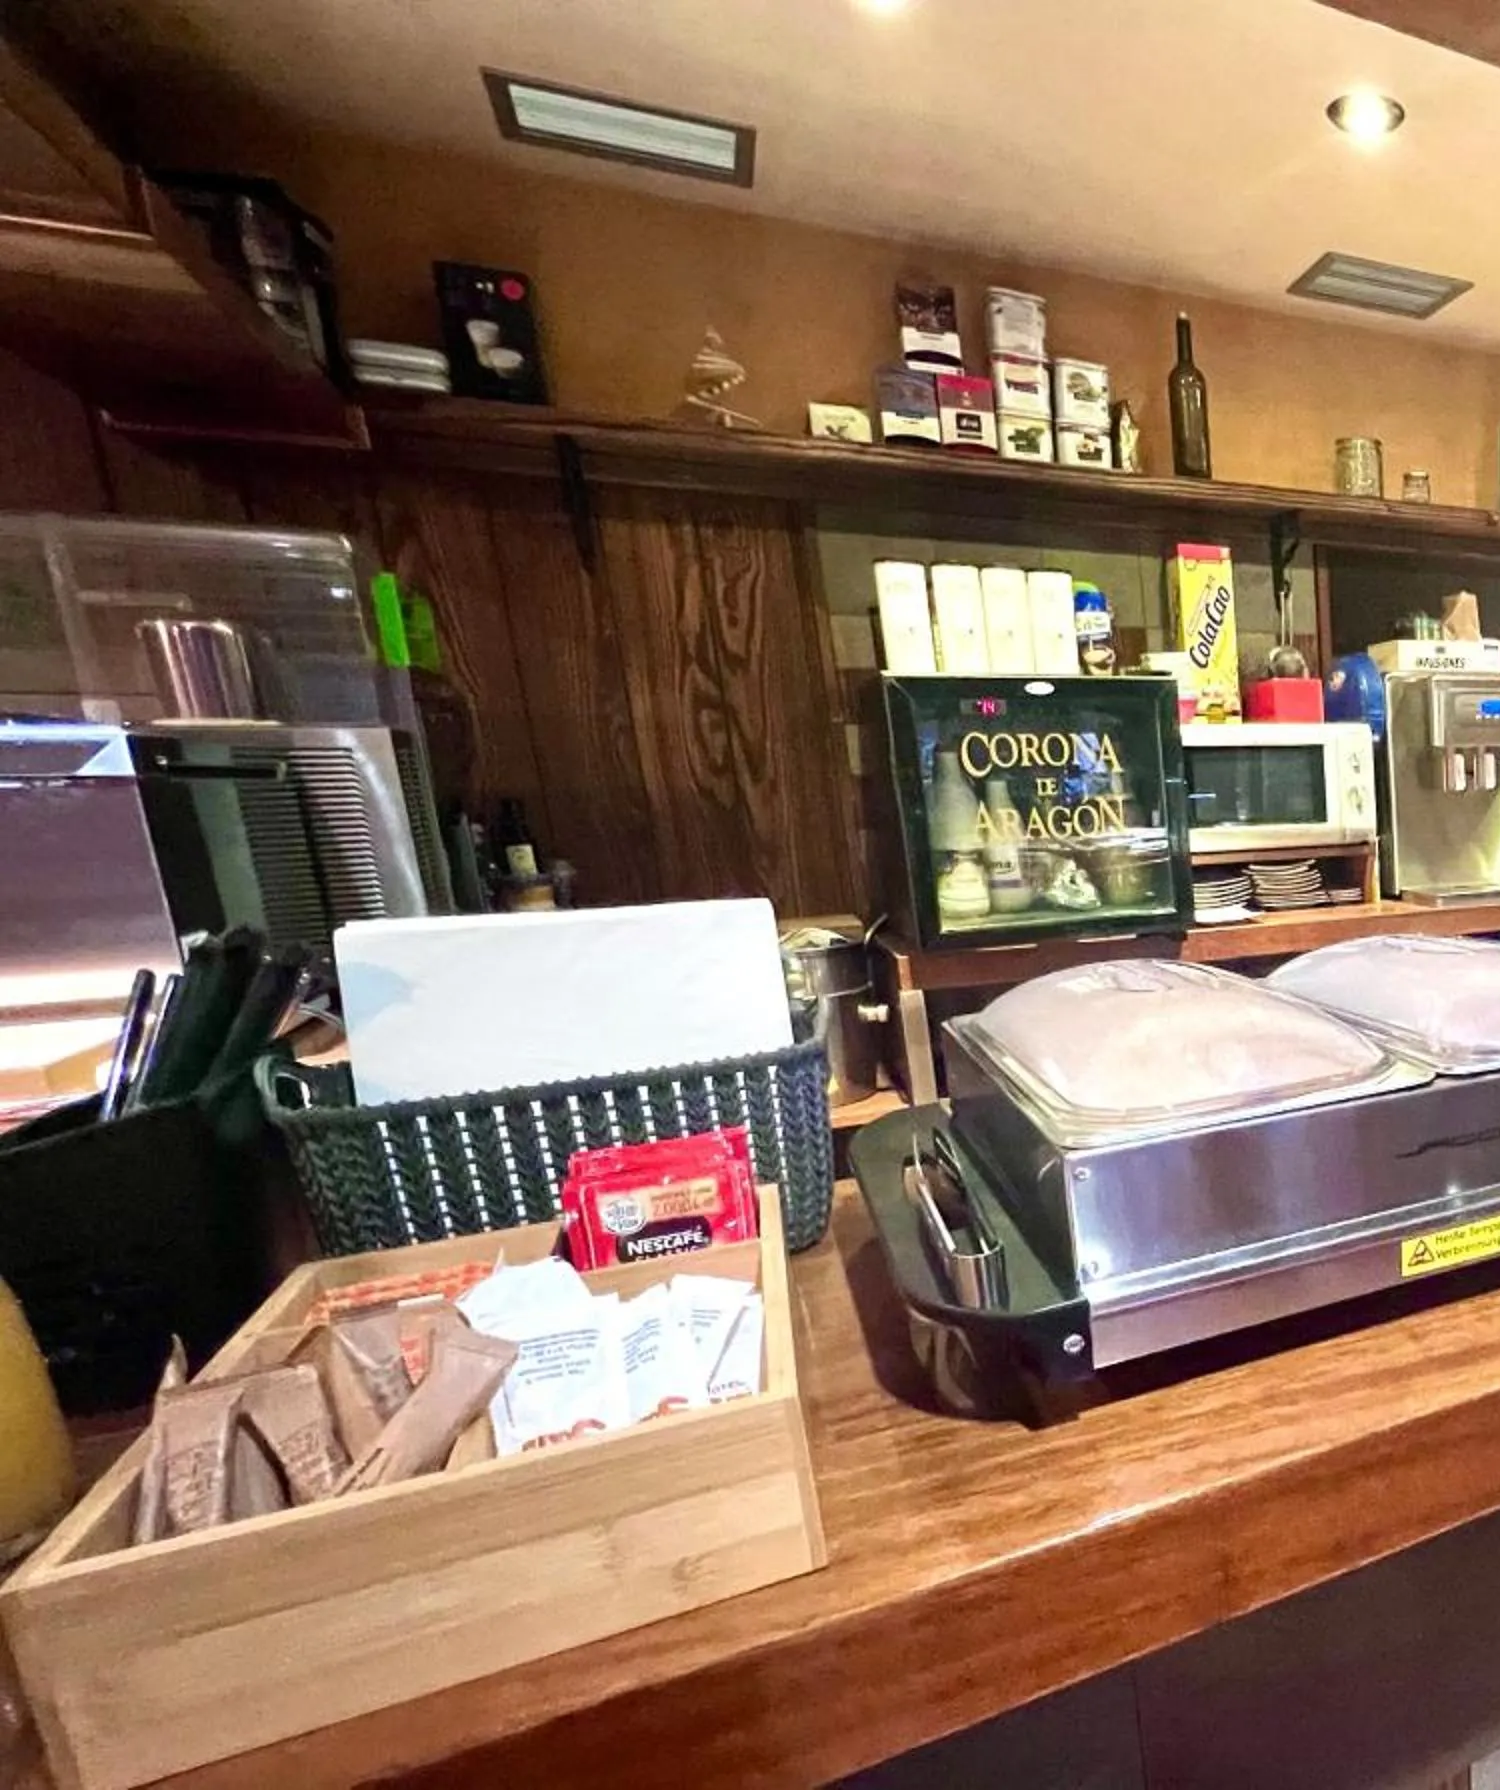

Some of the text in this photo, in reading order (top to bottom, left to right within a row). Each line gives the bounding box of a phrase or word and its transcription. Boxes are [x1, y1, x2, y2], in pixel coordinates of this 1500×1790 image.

[1189, 585, 1231, 669] ColaCao
[961, 731, 1124, 777] CORONA
[1036, 777, 1057, 796] DE
